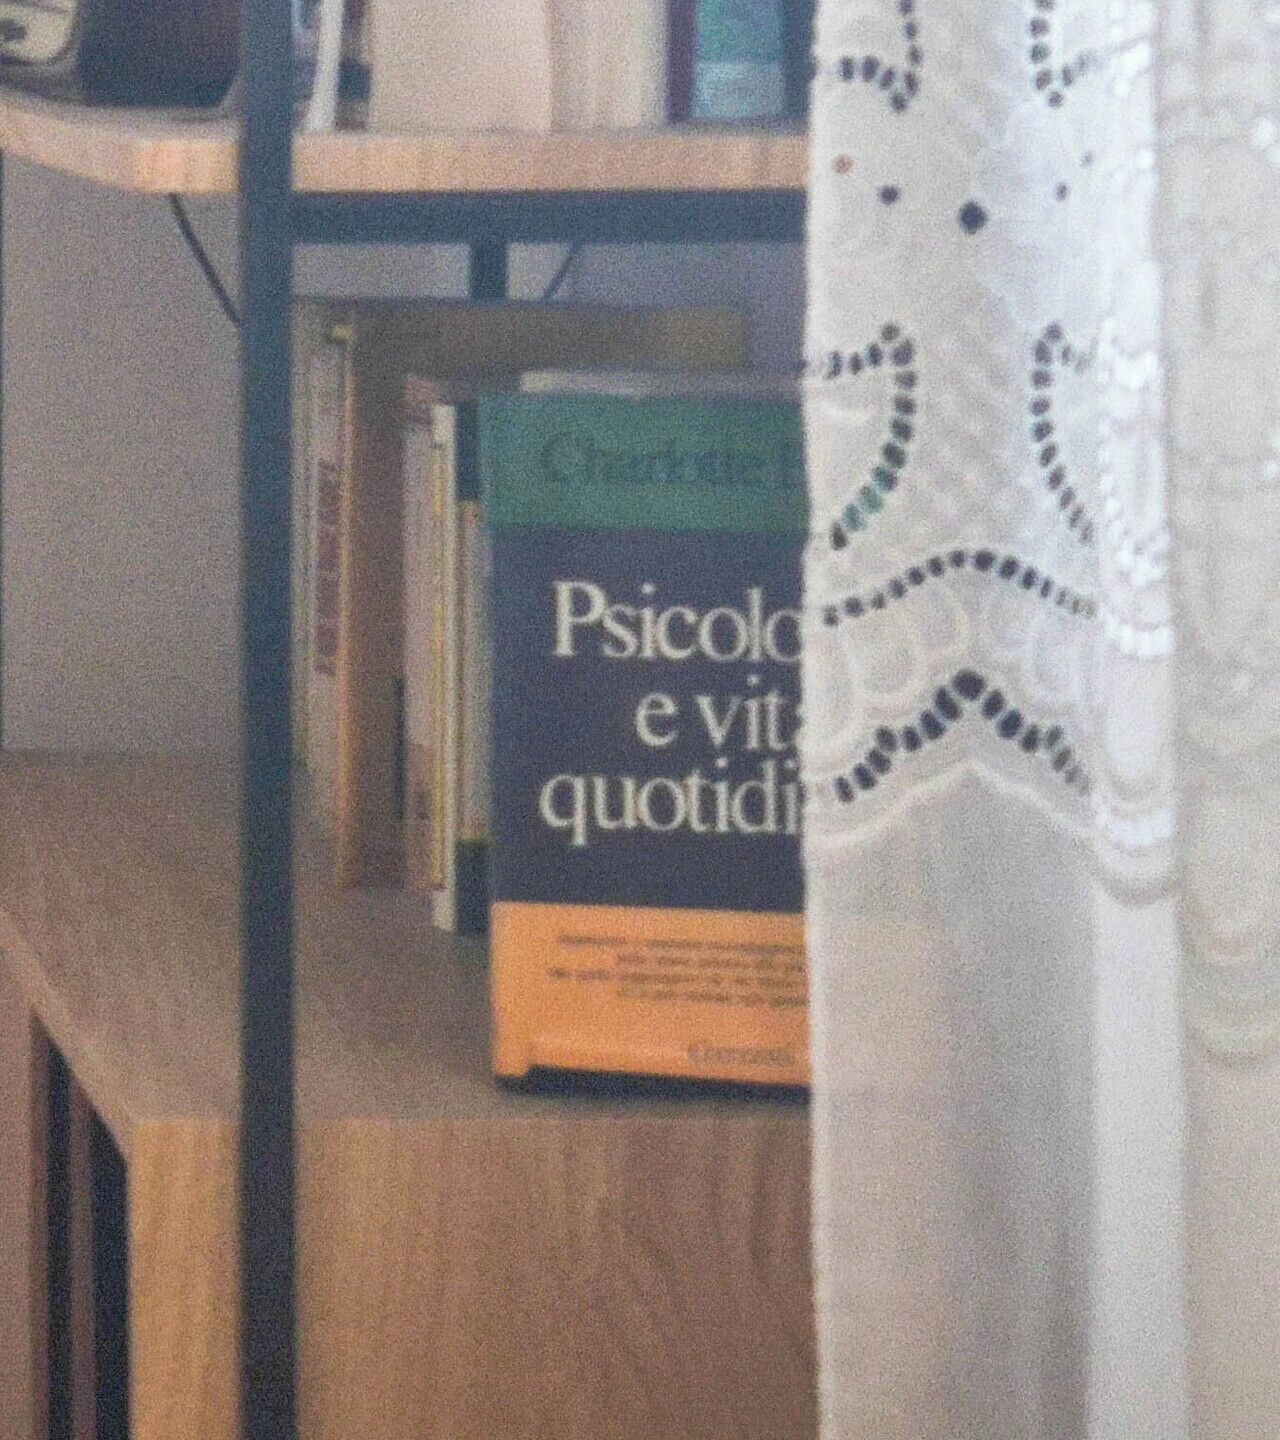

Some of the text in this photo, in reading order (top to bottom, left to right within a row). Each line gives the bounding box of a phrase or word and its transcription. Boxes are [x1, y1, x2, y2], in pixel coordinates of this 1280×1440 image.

[634, 672, 798, 750] e vit
[538, 756, 798, 848] quotidi
